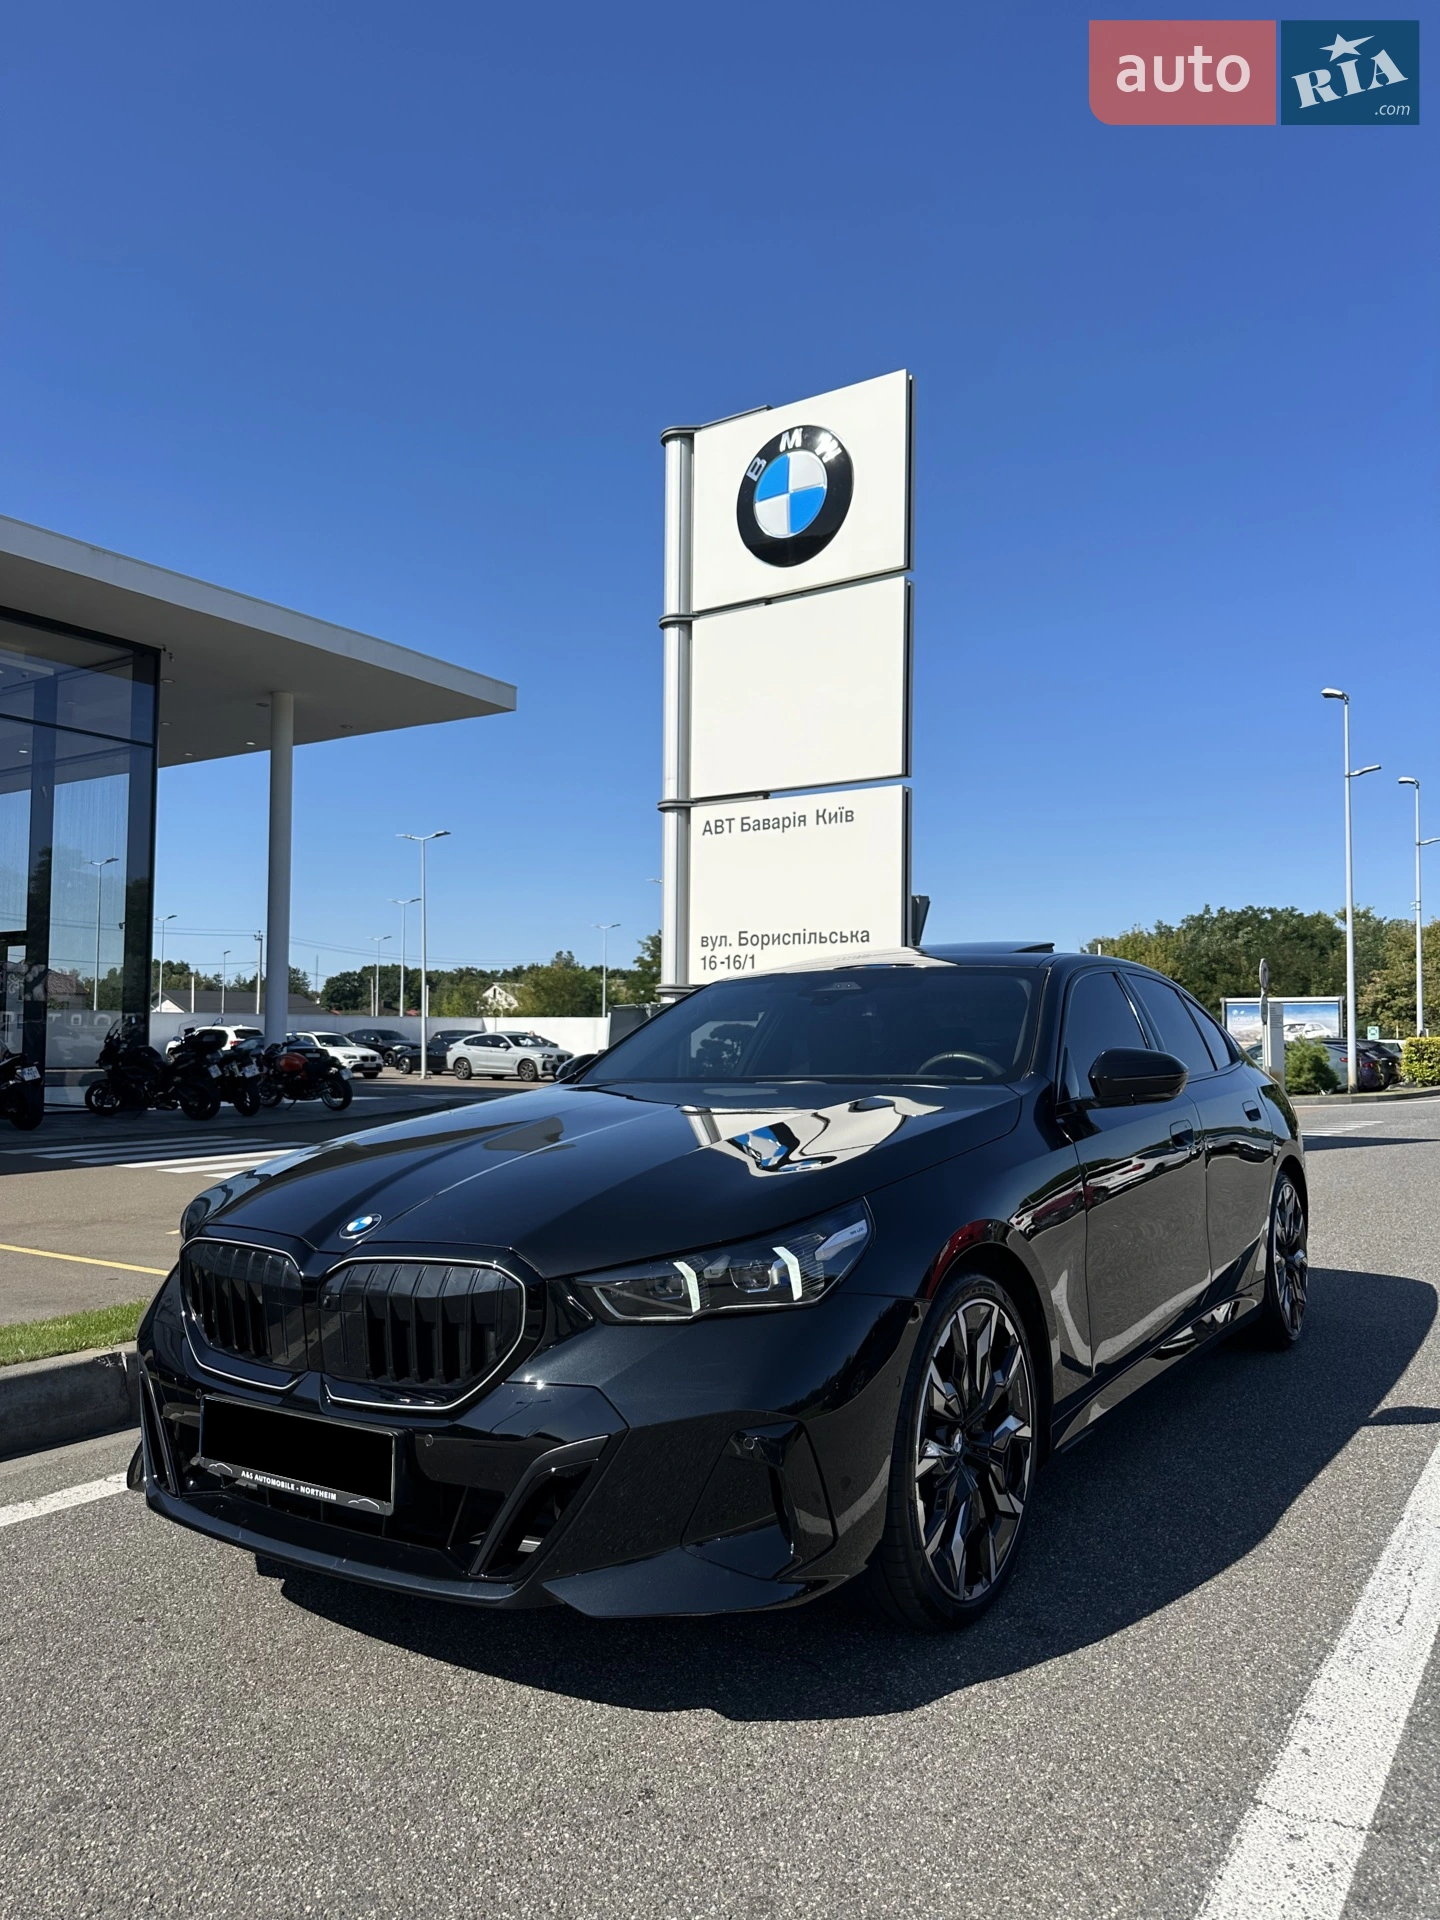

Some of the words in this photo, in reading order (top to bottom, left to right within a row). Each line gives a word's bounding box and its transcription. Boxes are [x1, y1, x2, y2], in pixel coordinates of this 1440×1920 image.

[746, 428, 842, 482] BMW
[702, 817, 735, 836] АВТ
[740, 811, 807, 834] Баварія
[815, 806, 855, 826] Київ
[700, 935, 733, 952] вул.
[738, 928, 870, 950] Бориспільська
[700, 954, 755, 971] 16-16/1
[241, 1470, 254, 1480] A&S
[254, 1474, 295, 1491] AUTOMOBILE
[300, 1485, 337, 1501] NORTHEIM
